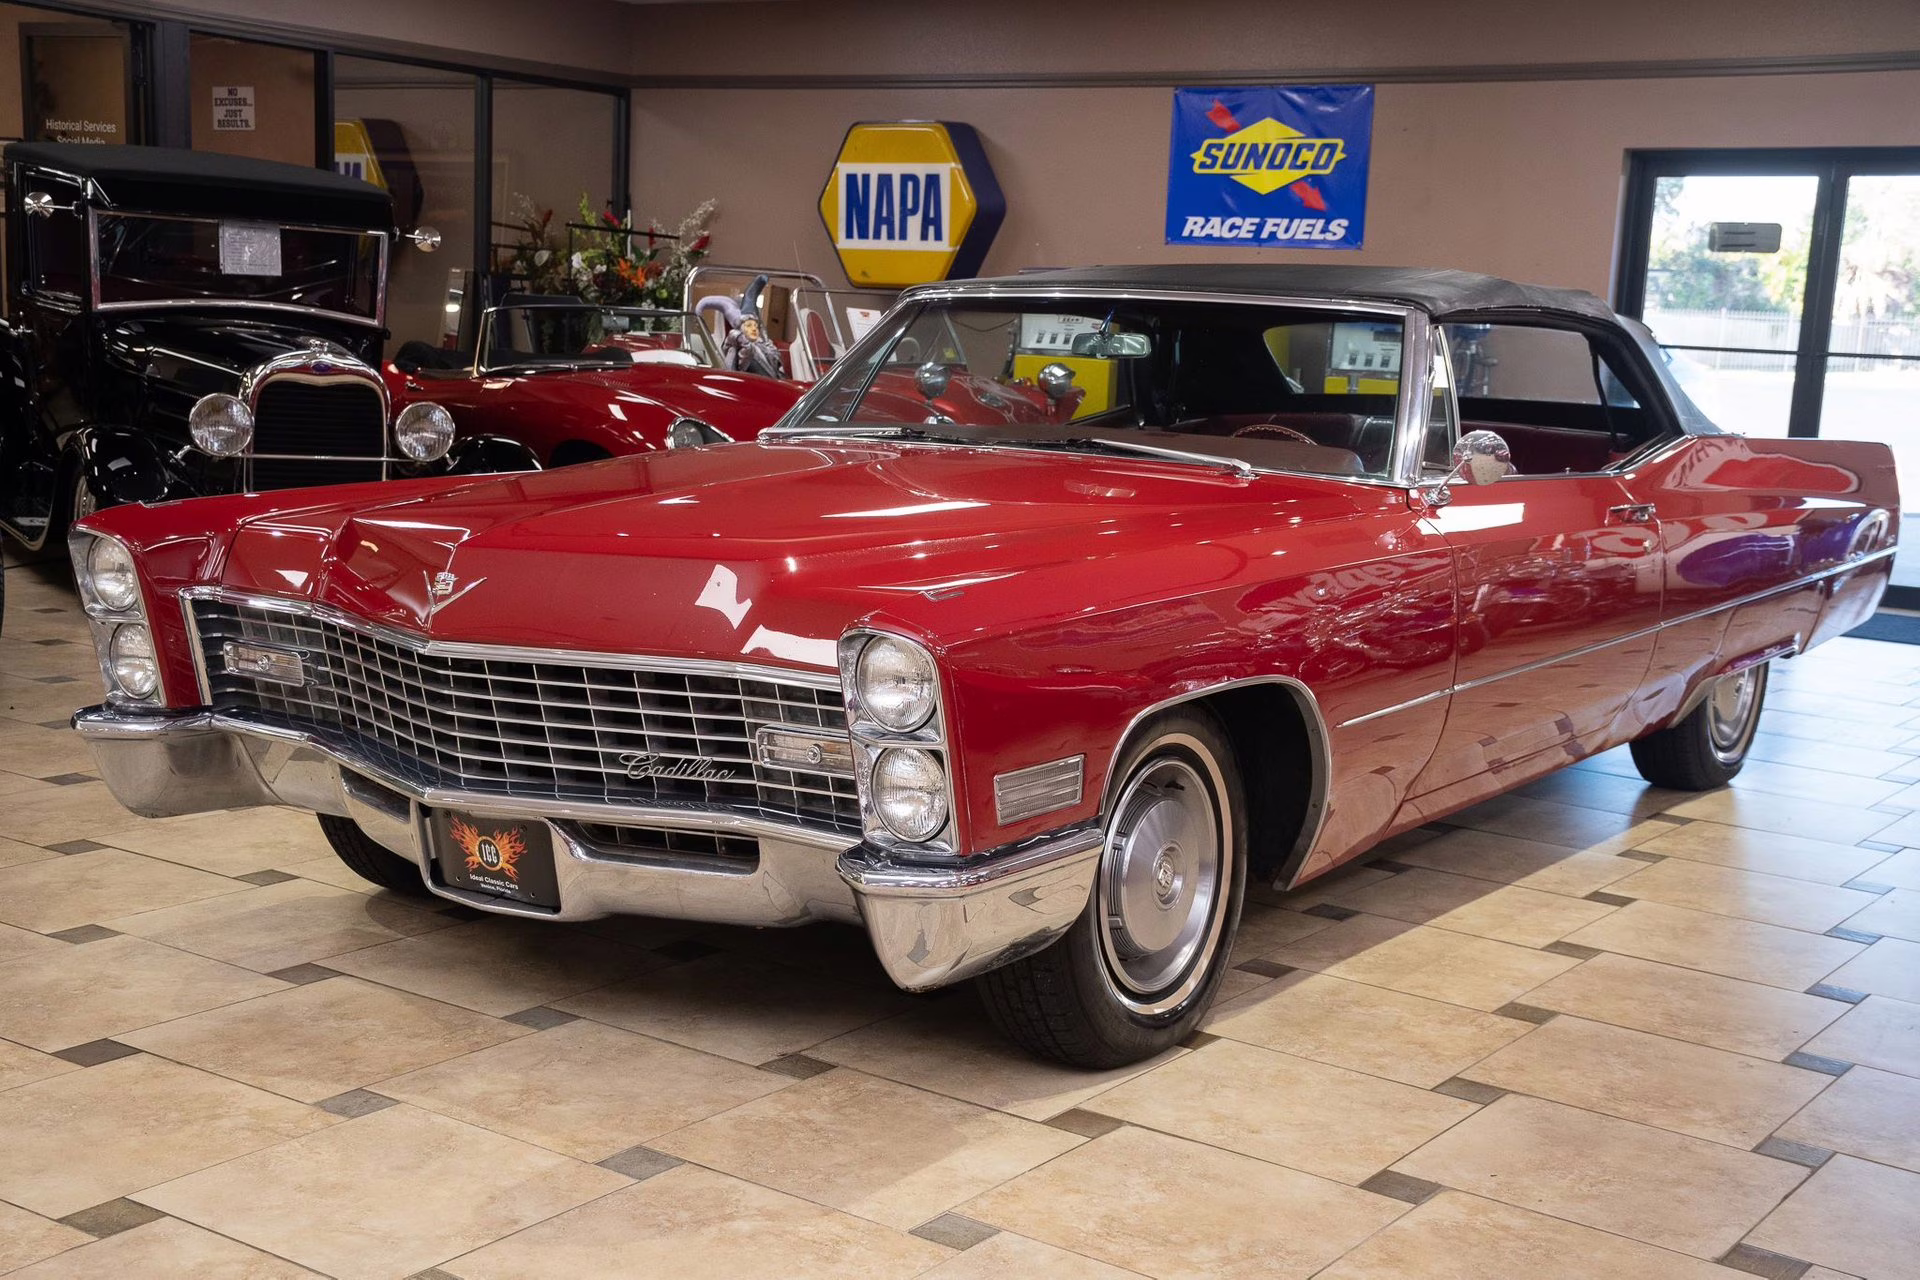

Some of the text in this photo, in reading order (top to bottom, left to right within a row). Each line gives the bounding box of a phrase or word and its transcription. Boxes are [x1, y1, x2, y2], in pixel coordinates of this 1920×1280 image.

[227, 87, 238, 96] NO
[224, 109, 243, 118] JUST
[45, 119, 117, 133] Historical Services
[1199, 142, 1340, 171] SUNOCO
[845, 173, 943, 242] NAPA
[1181, 216, 1350, 241] RACE FUELS
[619, 752, 736, 780] Cadillac
[481, 843, 498, 864] ICC
[469, 873, 519, 890] Ideal Classic Cars
